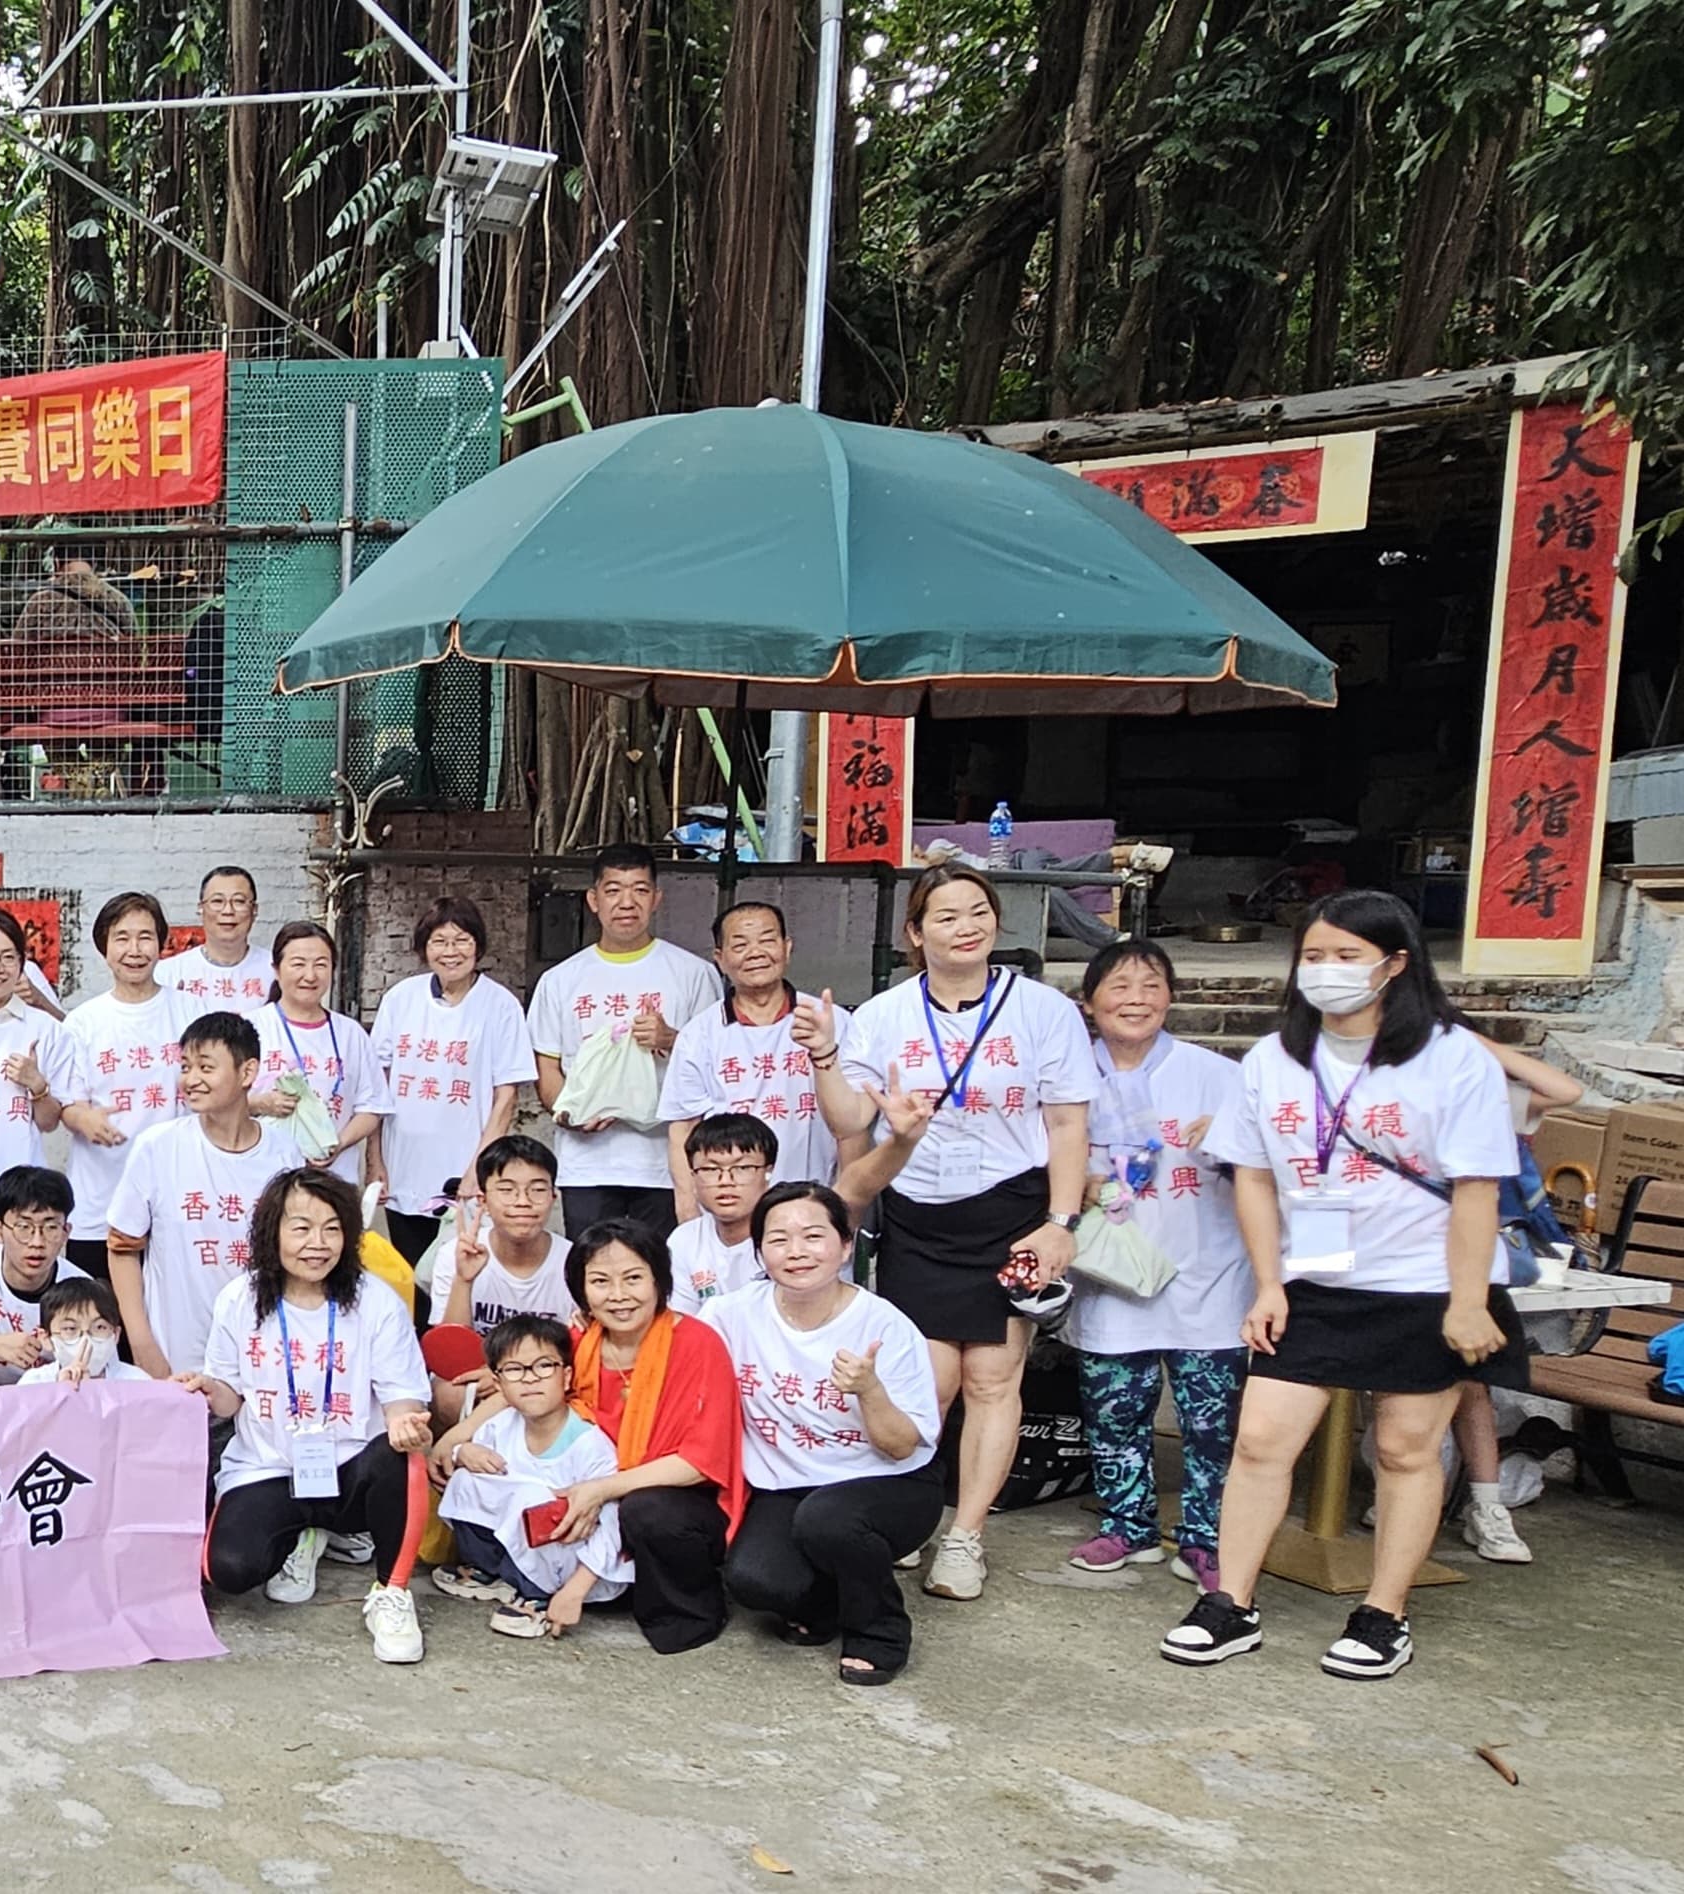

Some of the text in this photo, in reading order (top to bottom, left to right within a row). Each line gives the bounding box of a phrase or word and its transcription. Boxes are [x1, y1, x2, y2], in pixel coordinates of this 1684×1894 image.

[397, 1033, 469, 1066] 香港穩
[718, 1049, 812, 1083] 香港穩
[397, 1071, 472, 1107] 百業興
[246, 1336, 347, 1375] 香港穩
[736, 1363, 850, 1413] 香港穩
[256, 1388, 354, 1426] 百業興
